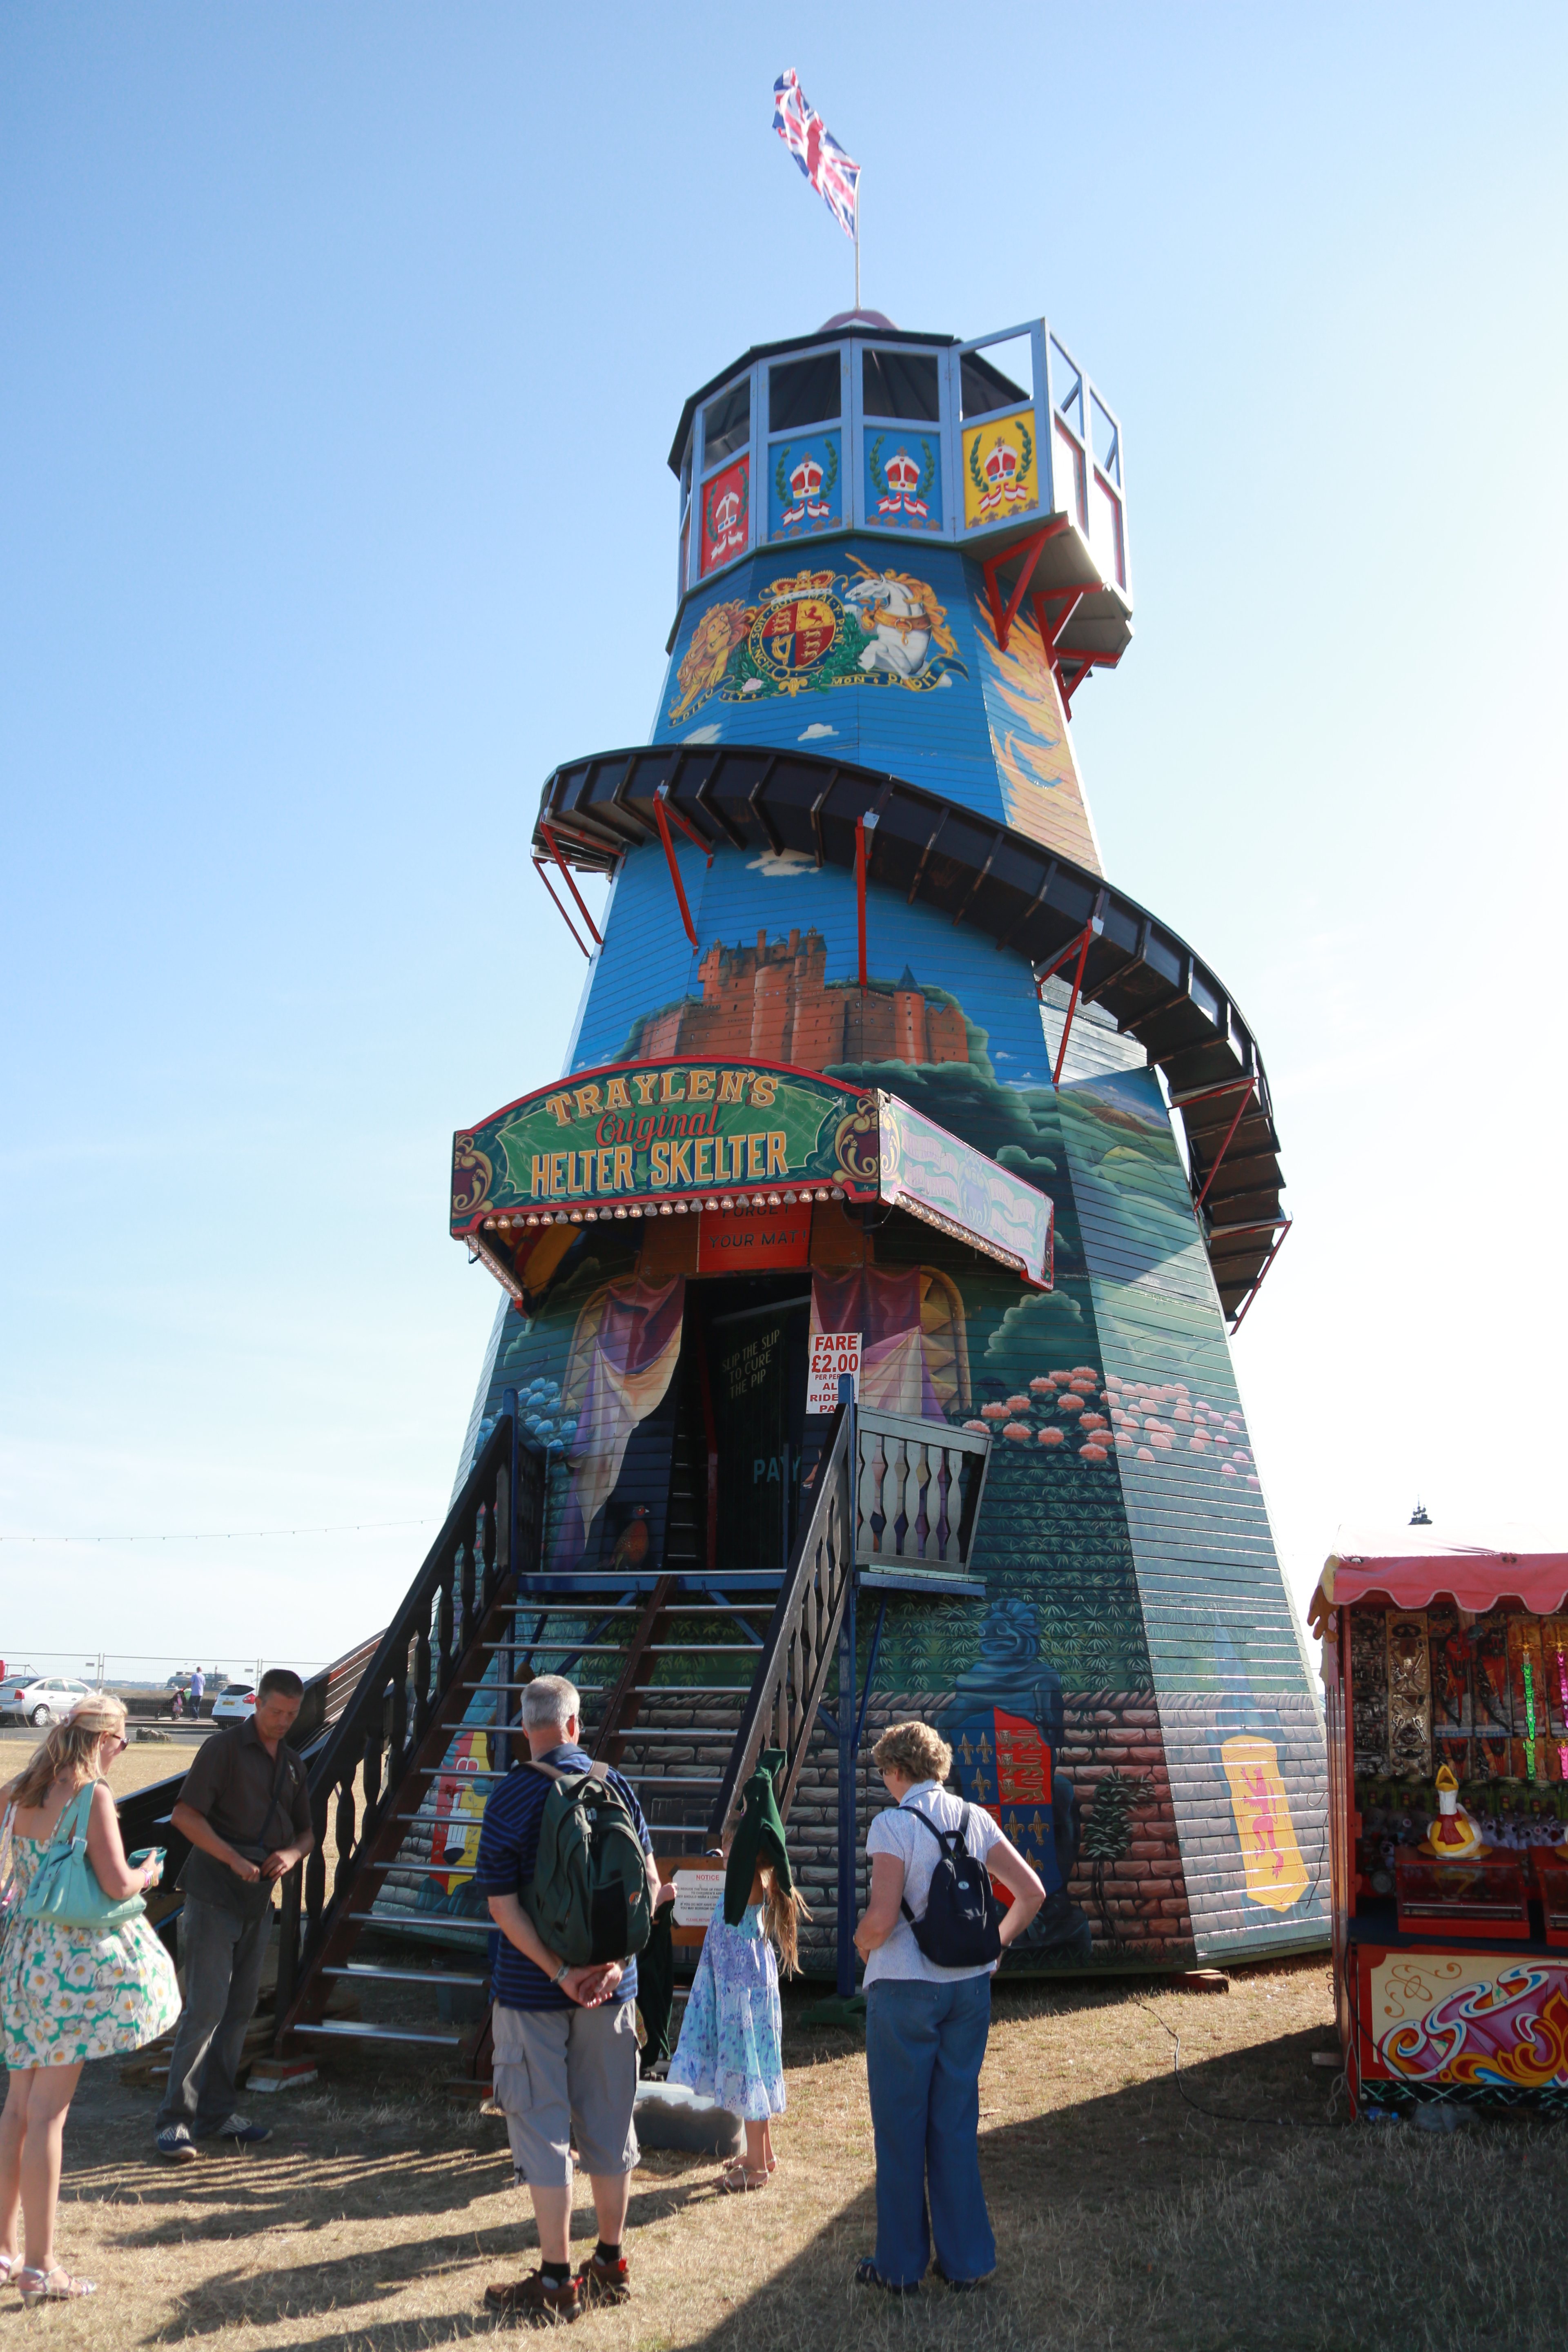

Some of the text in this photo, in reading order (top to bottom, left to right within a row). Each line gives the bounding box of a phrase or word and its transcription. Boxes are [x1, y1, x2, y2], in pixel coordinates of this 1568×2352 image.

[752, 615, 767, 639] SOIT
[807, 593, 833, 605] MAL
[831, 676, 865, 685] MON
[546, 1070, 778, 1127] TRAYLEN'S
[595, 1104, 724, 1152] Original
[530, 1131, 789, 1200] HELTER SKELTER
[722, 1202, 789, 1218] FORGET
[708, 1234, 754, 1248] YOUR
[722, 1329, 780, 1372] SLIP THE SLIP
[815, 1335, 858, 1351] FARE
[729, 1349, 771, 1383] TO CURE
[811, 1353, 858, 1373] £2.00
[730, 1369, 766, 1399] THE PIP
